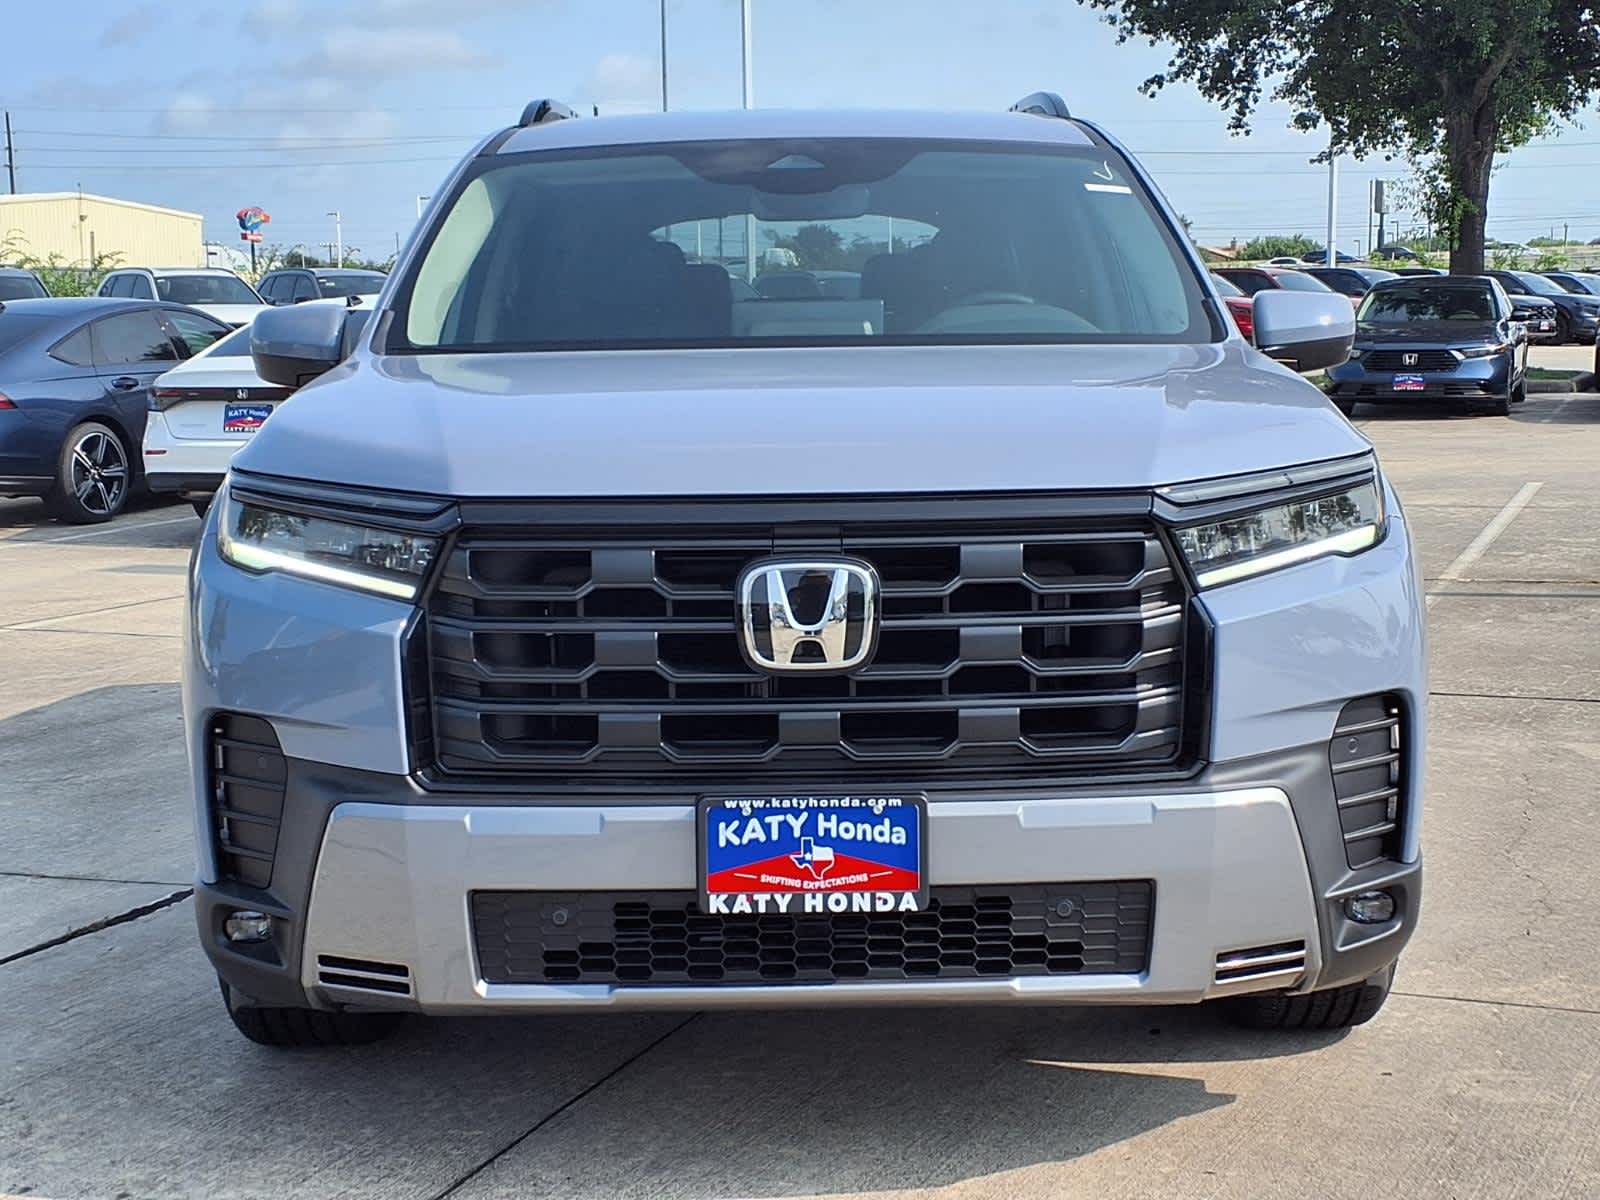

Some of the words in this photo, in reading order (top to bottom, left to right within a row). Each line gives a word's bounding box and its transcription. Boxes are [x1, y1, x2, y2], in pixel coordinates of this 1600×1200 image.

[228, 408, 248, 416] KATY
[724, 797, 902, 810] www.katyhonda.com
[718, 811, 809, 848] KATY
[817, 812, 906, 845] Honda
[760, 873, 802, 889] SHIFTING
[802, 873, 869, 890] EXPECTATIONS
[709, 892, 793, 914] KATY
[804, 891, 919, 913] HONDA
